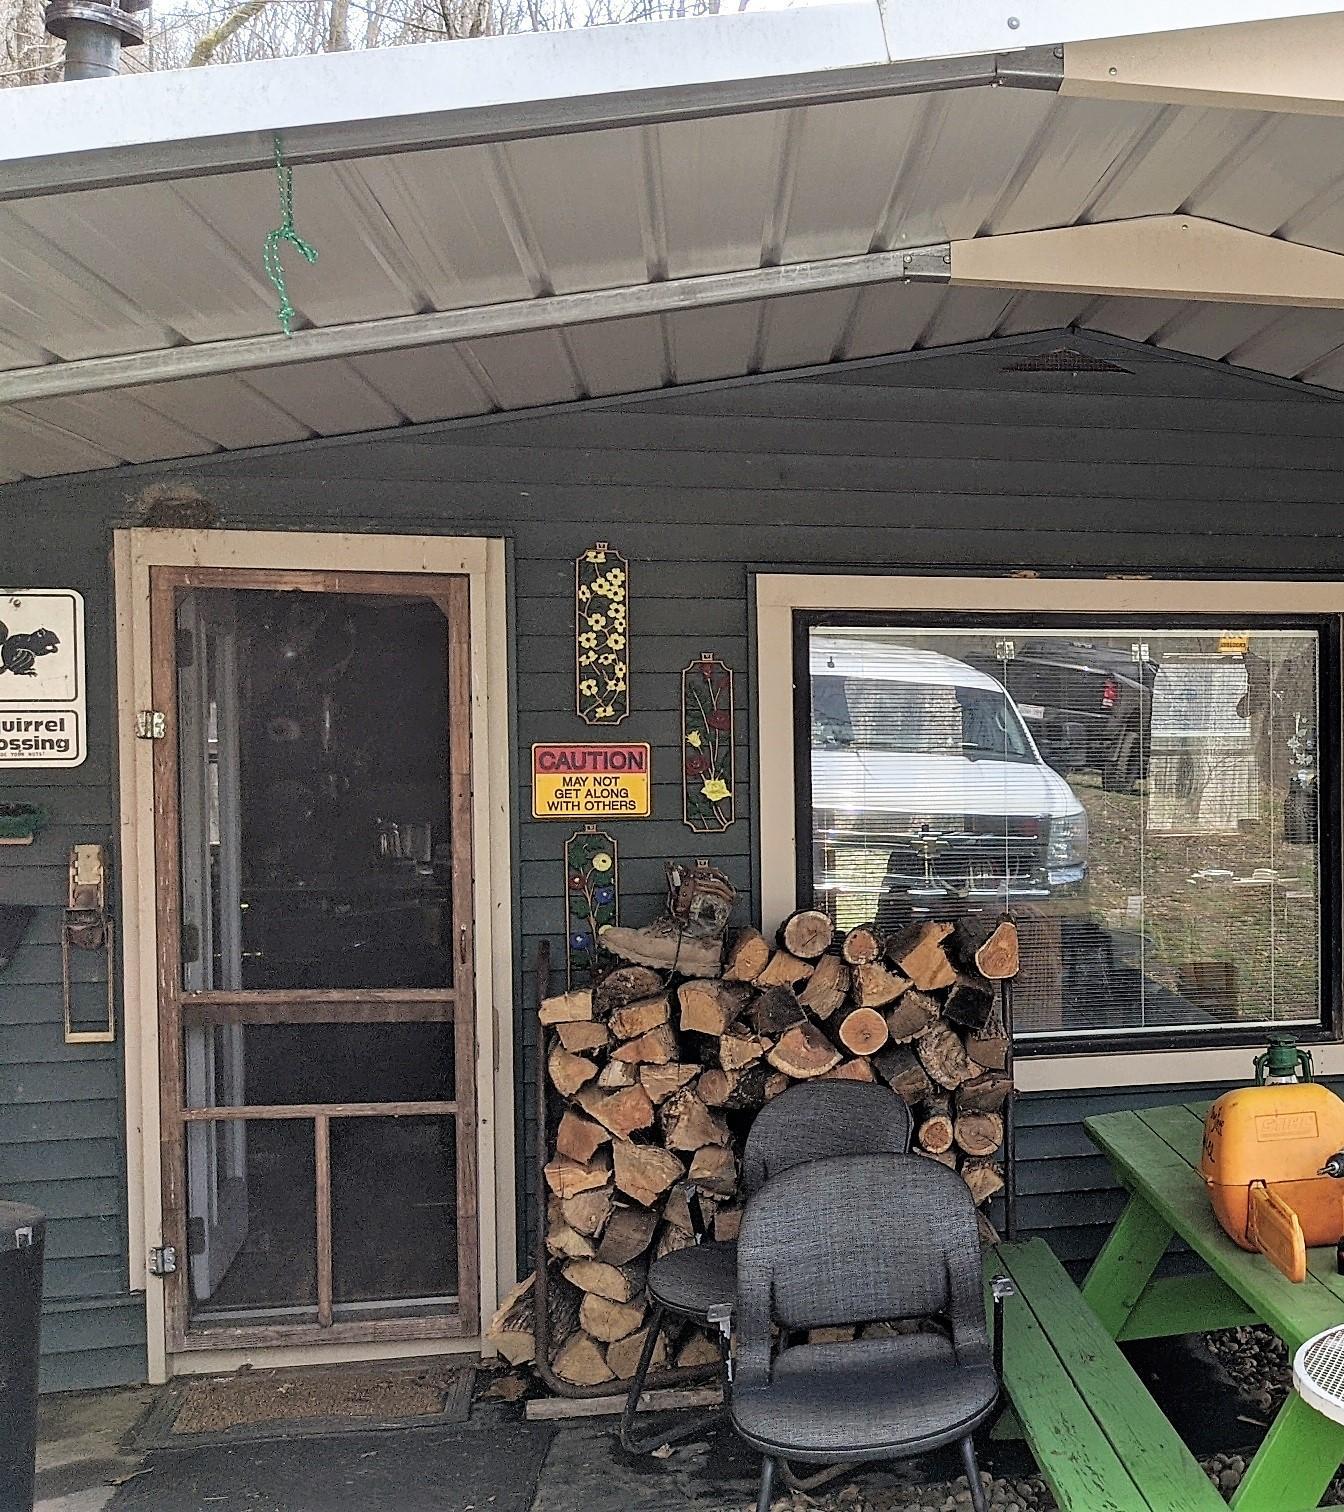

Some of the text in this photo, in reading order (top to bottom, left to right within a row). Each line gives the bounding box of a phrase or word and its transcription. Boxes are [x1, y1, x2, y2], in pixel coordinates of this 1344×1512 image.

[0, 717, 65, 732] uirrel
[539, 751, 644, 770] CAUTION
[562, 776, 620, 787] MAY NOT
[554, 788, 629, 799] GET ALONG
[547, 800, 636, 811] WITH OTHERS
